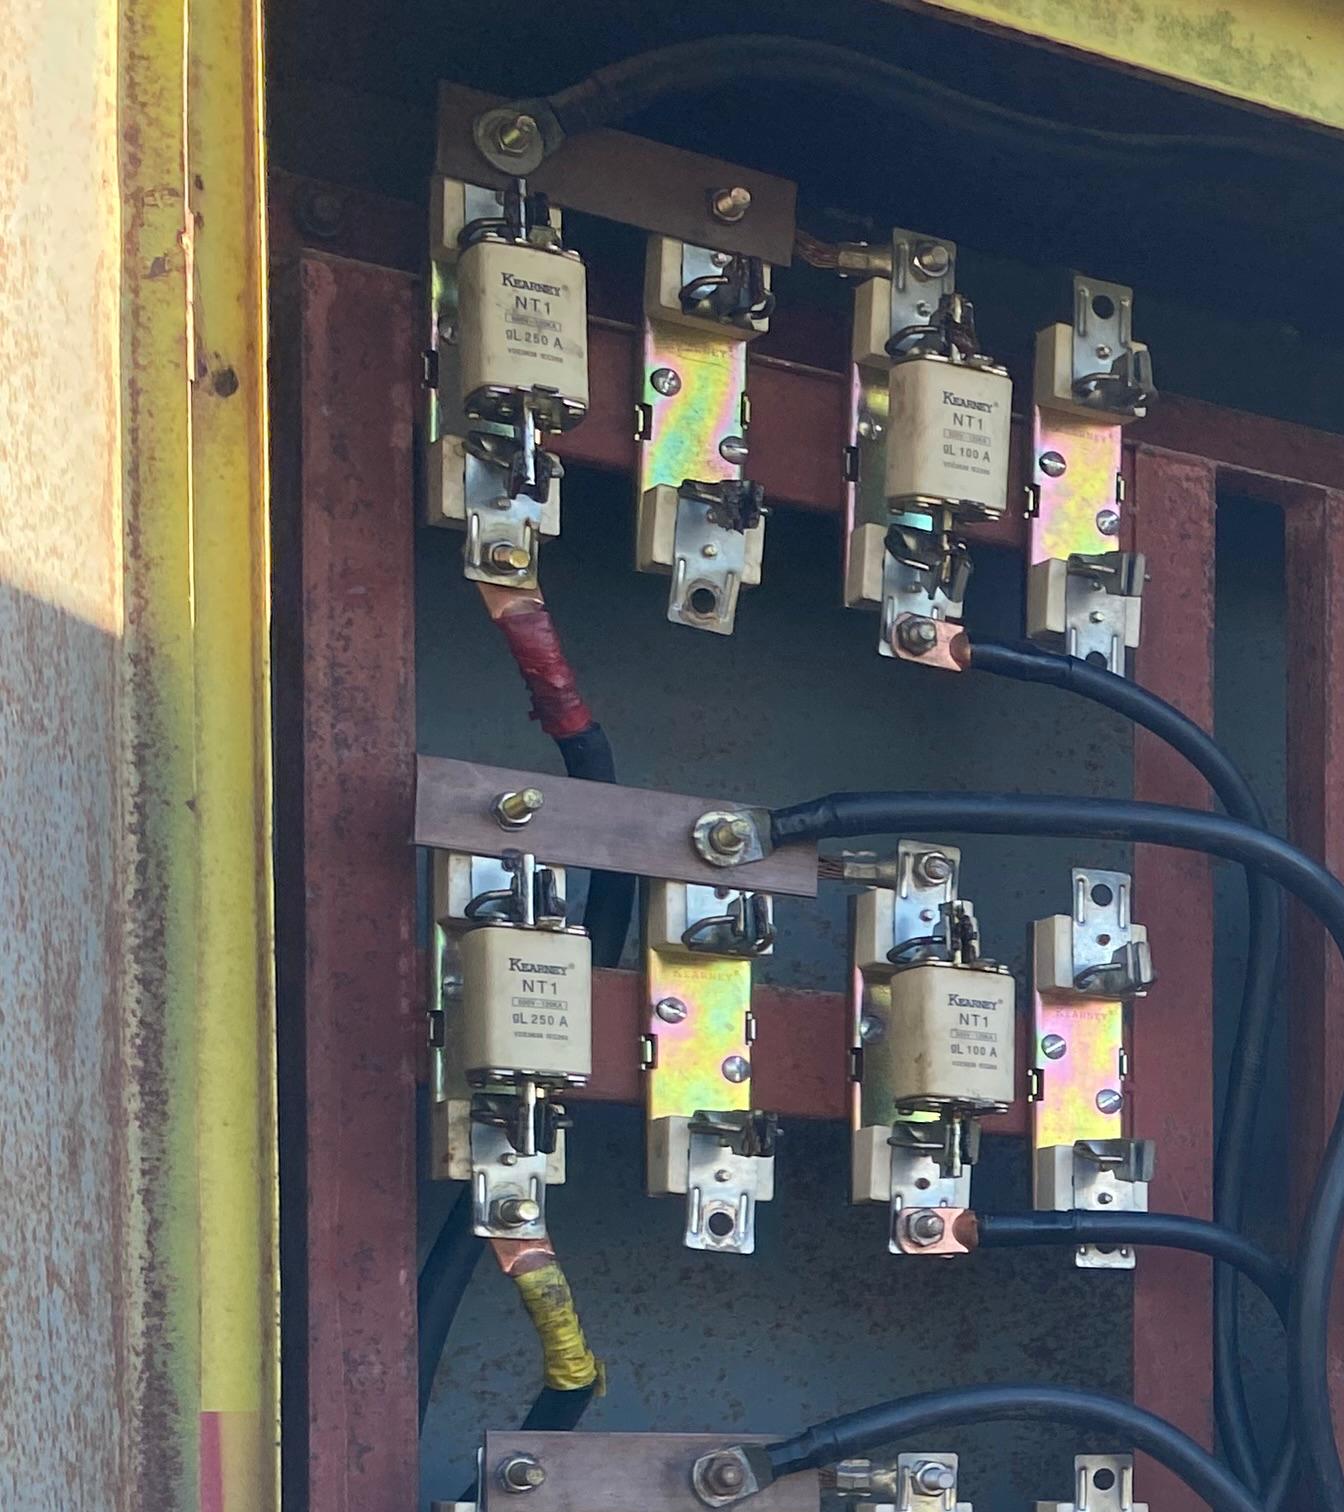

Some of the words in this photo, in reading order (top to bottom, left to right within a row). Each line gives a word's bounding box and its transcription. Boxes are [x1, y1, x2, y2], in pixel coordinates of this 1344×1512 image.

[515, 296, 550, 315] NT1
[525, 332, 549, 346] 250
[553, 337, 563, 350] A
[953, 412, 983, 431] NT1
[960, 447, 979, 459] 100
[982, 451, 990, 463] A
[522, 979, 558, 995] NT1
[531, 1014, 555, 1026] 250
[559, 1016, 568, 1027] A
[959, 1013, 988, 1028] NT1
[967, 1045, 986, 1056] 100
[989, 1046, 998, 1058] A
